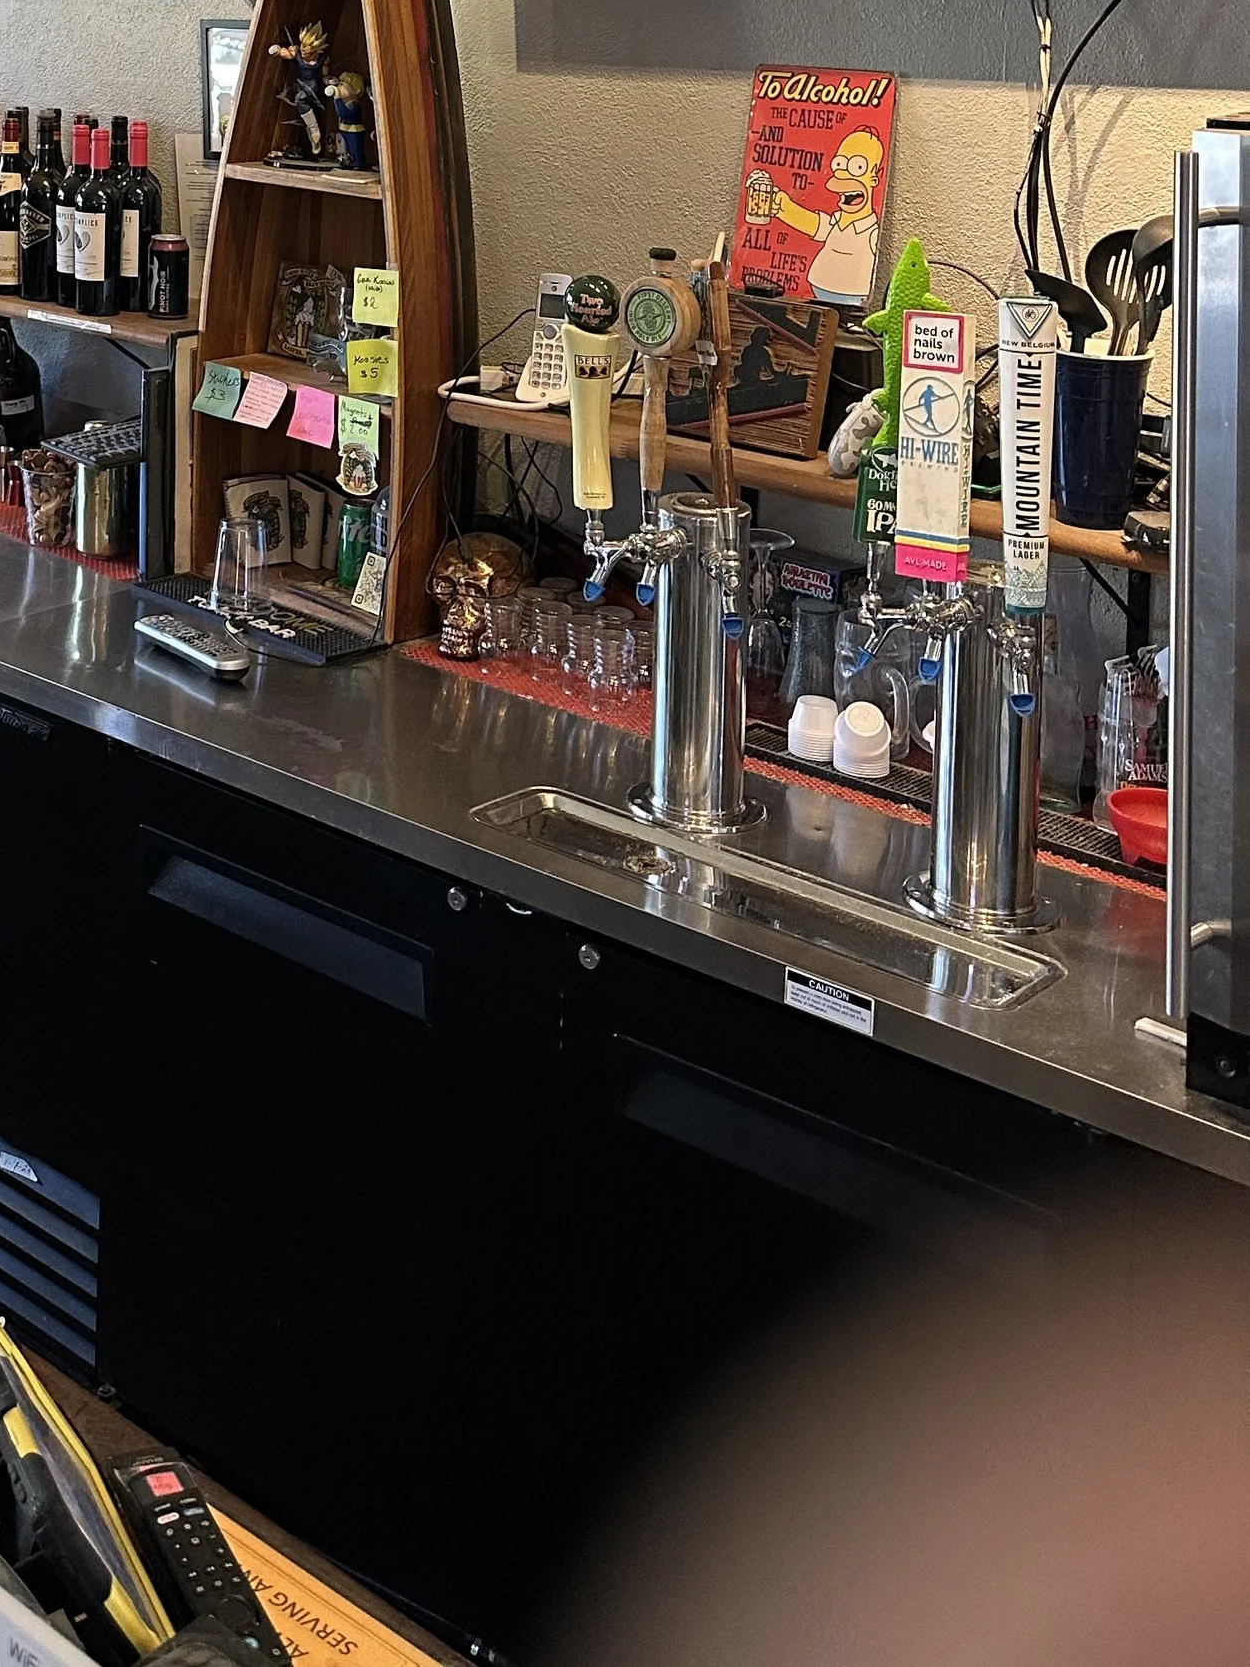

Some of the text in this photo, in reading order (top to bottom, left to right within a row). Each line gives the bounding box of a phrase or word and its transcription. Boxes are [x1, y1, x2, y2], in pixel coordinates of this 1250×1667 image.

[757, 70, 792, 99] To
[770, 106, 847, 130] THE CAUSE OF
[752, 144, 824, 172] SOLUTION
[742, 227, 788, 251] ALL OF
[771, 252, 807, 273] LIFE'S
[580, 294, 604, 305] Two
[915, 324, 955, 339] bed of
[914, 336, 943, 350] nails
[913, 347, 955, 364] brown
[900, 437, 959, 465] HI-WIRE
[1015, 359, 1042, 531] MOUNTAIN TIME
[1008, 540, 1045, 551] PREMIUM
[1013, 549, 1040, 561] LAGER
[922, 558, 948, 572] MADE
[808, 979, 850, 1002] CAUTION
[268, 1591, 359, 1656] SERVING
